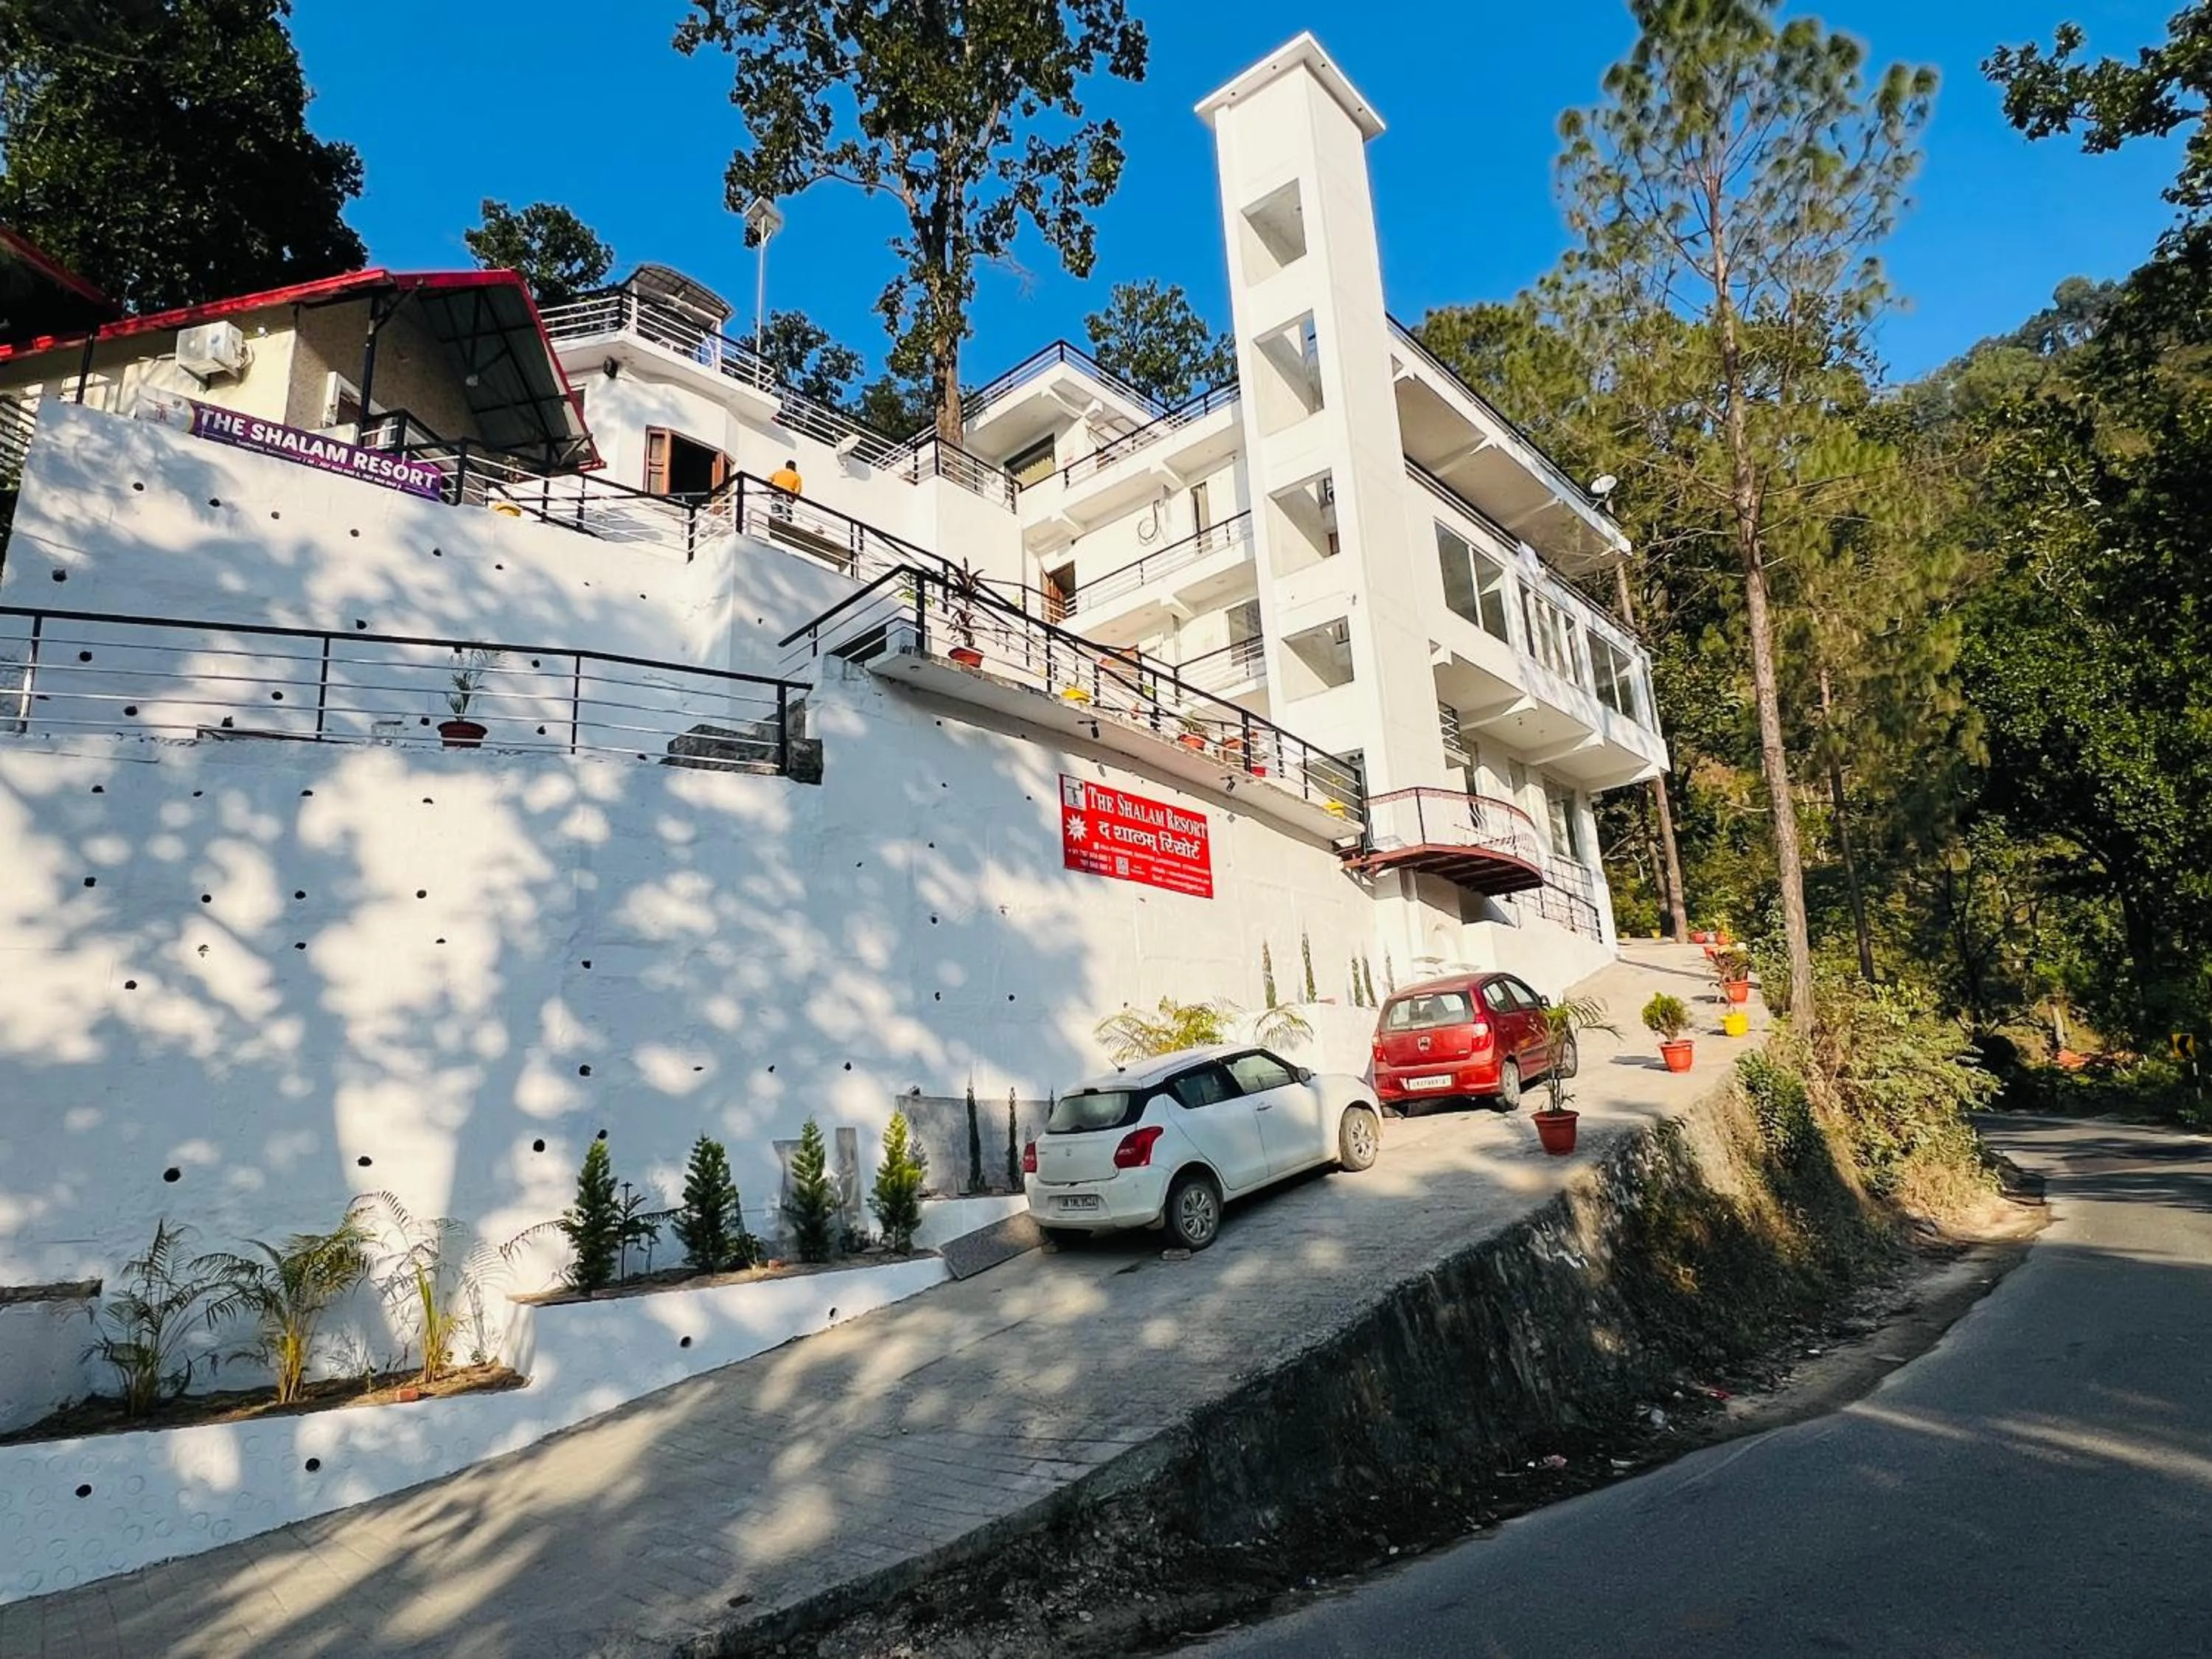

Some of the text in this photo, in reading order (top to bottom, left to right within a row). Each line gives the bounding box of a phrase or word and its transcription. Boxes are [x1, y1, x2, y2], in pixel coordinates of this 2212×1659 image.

[200, 408, 246, 437] THE
[251, 423, 347, 464] SHALAM
[353, 451, 437, 490] RESORT
